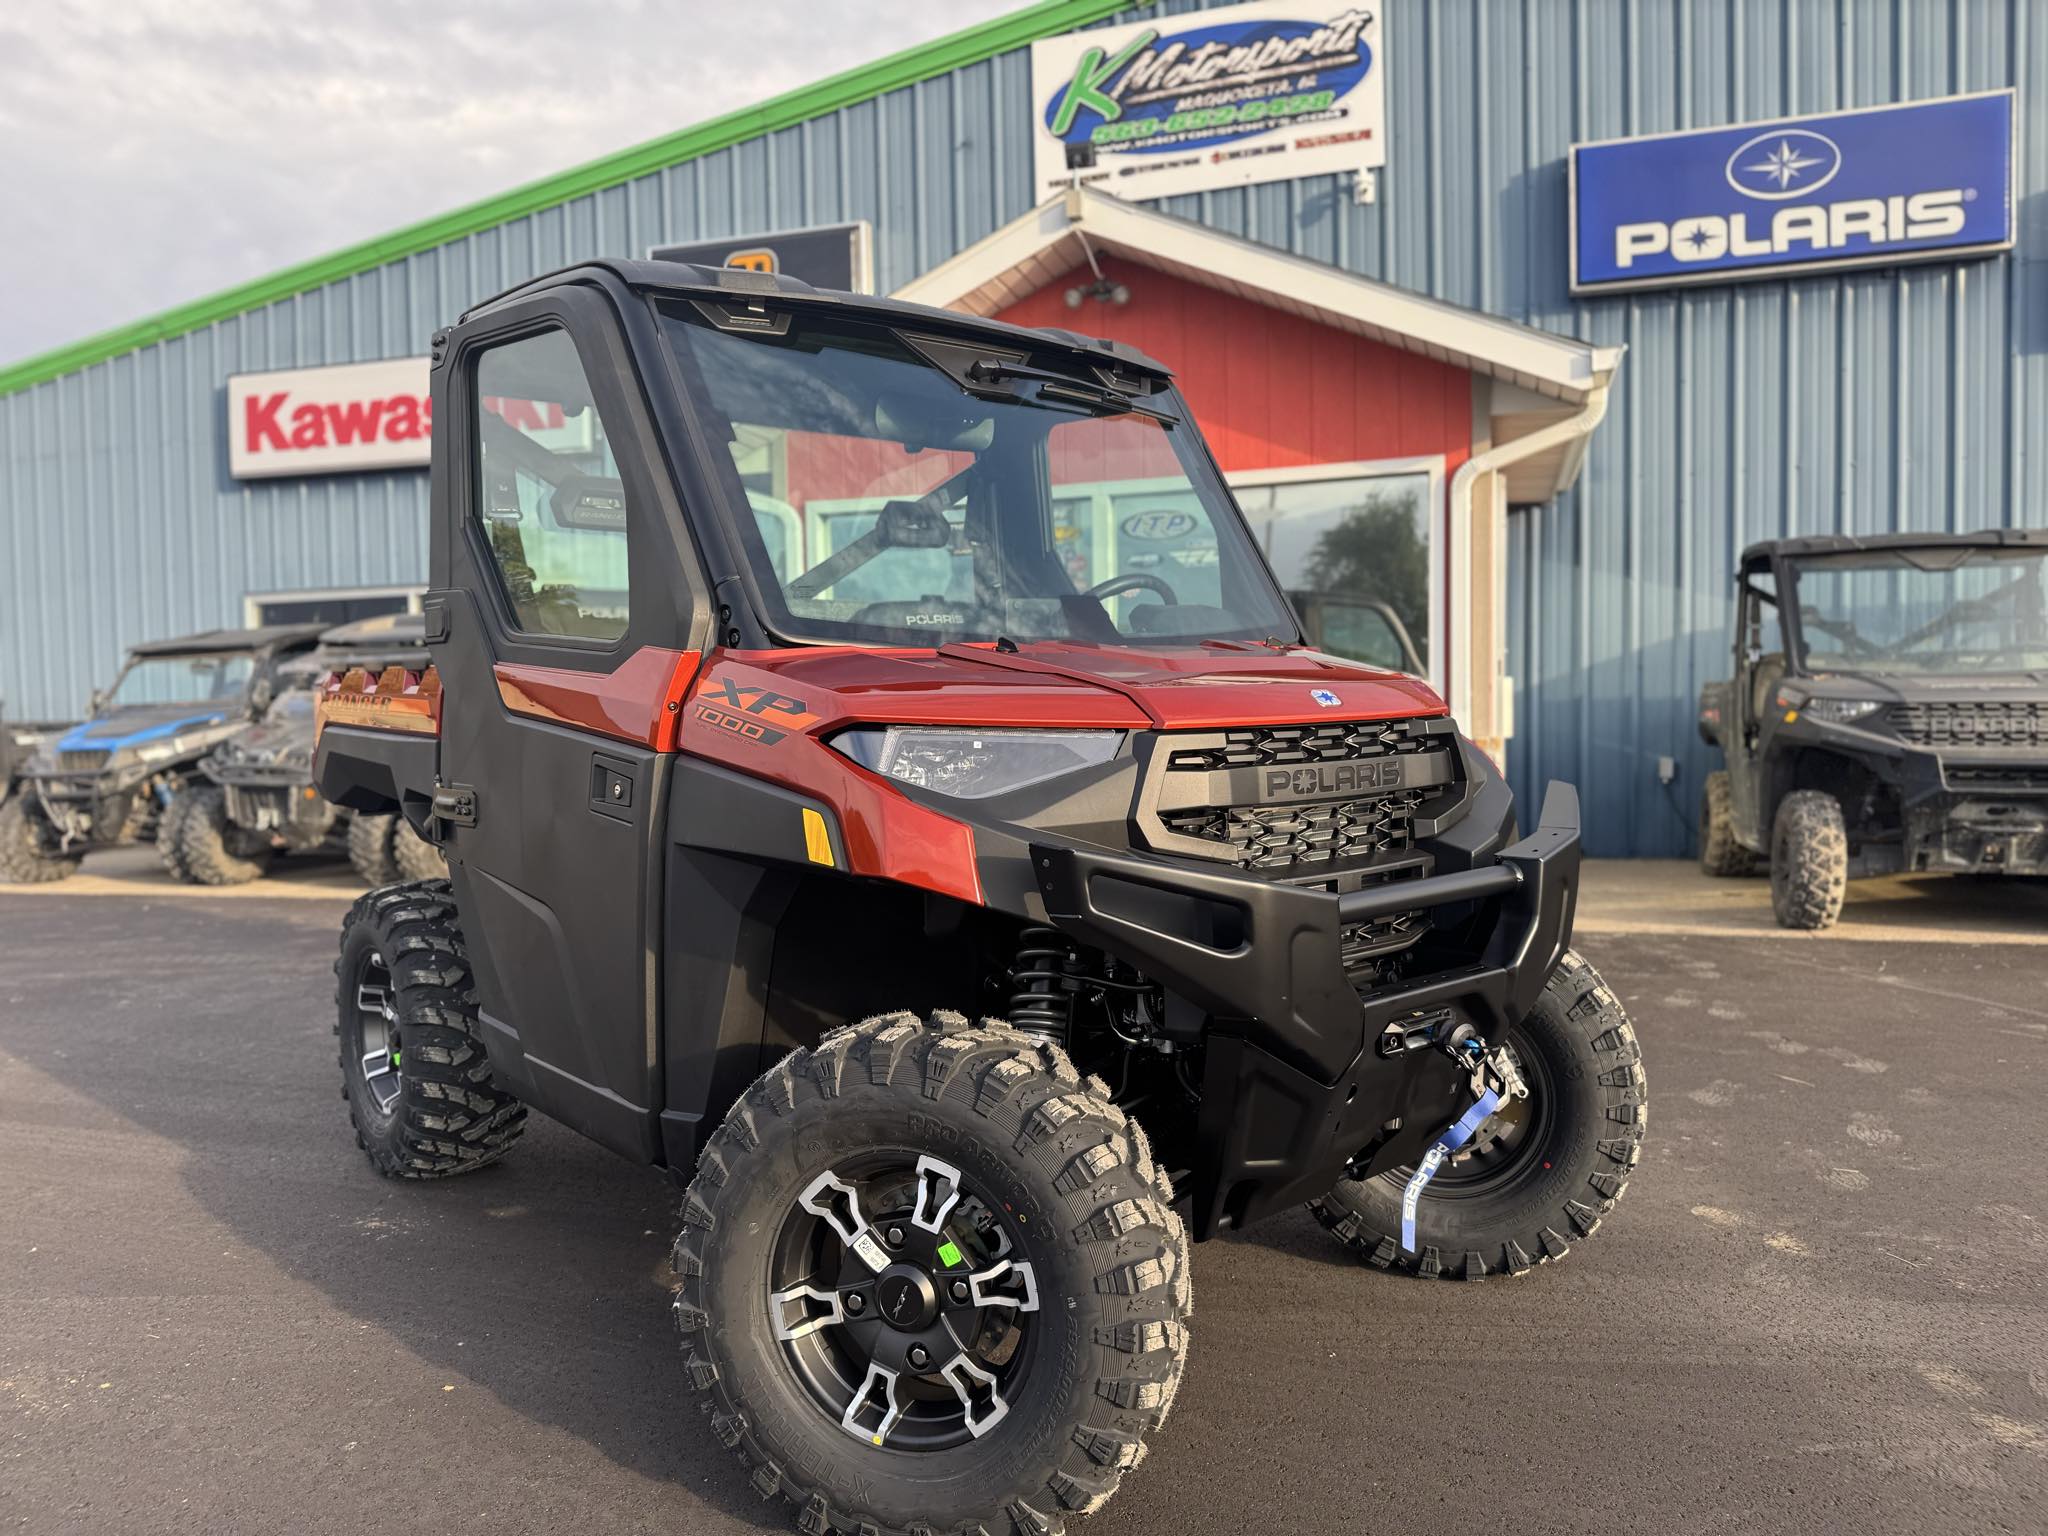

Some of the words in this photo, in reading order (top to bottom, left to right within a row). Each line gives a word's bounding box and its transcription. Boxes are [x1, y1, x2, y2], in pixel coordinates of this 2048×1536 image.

[1050, 29, 1160, 138] K
[1110, 9, 1373, 99] Motorsports
[1615, 188, 1967, 269] POLARIS
[1131, 514, 1186, 533] ITP
[906, 613, 964, 625] POLARIS
[701, 677, 808, 716] XP
[694, 705, 765, 739] 1000
[1266, 761, 1401, 797] POLARIS
[1404, 1142, 1450, 1222] POLARIS
